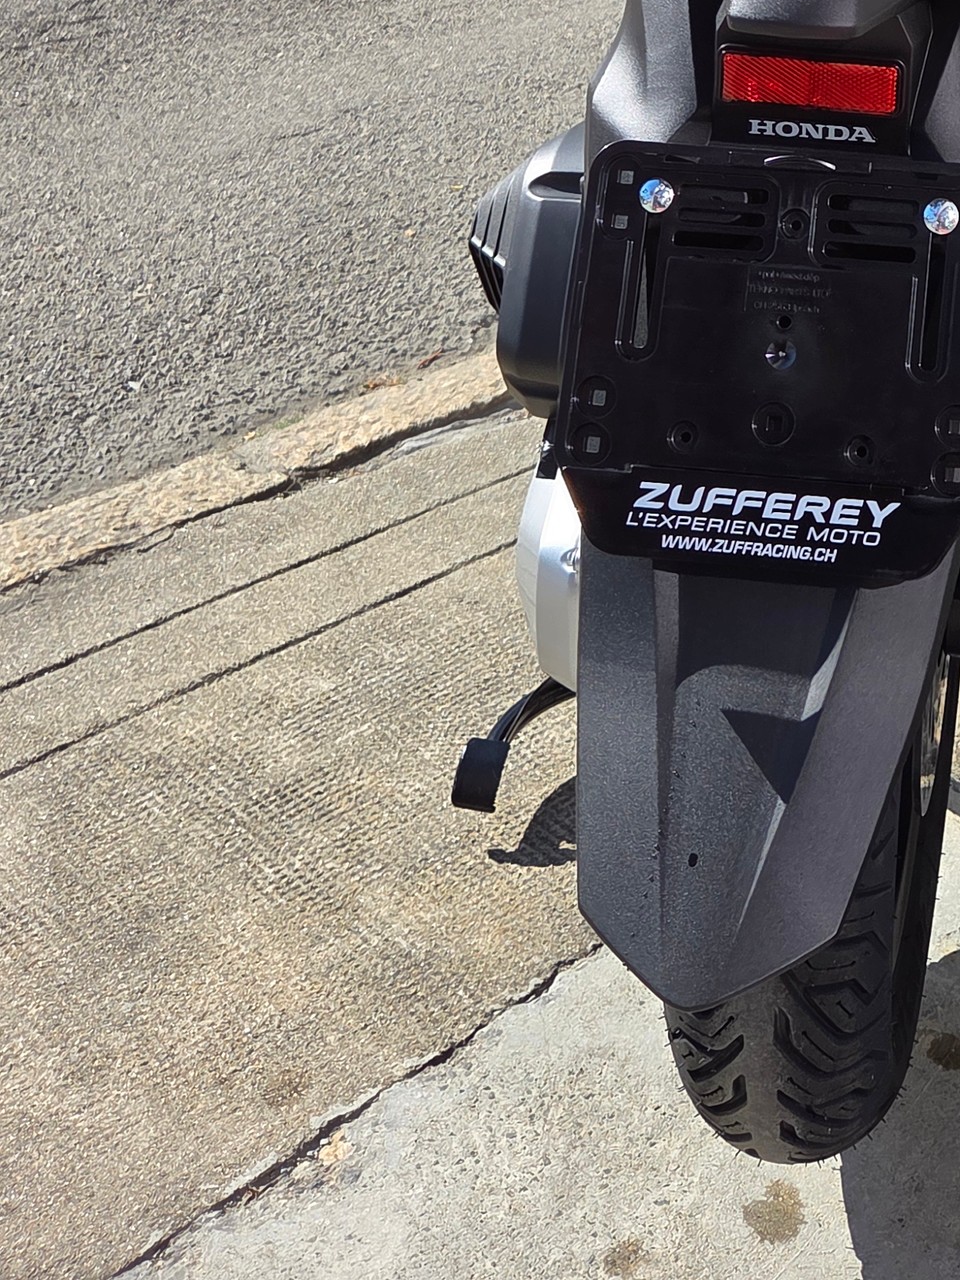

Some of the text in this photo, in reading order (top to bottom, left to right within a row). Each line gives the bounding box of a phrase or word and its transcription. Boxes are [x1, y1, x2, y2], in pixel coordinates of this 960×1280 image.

[748, 119, 877, 143] HONDA
[632, 481, 902, 529] ZUFFEREY
[625, 511, 882, 547] L'EXPERIENCE MOTO
[660, 534, 838, 563] WWW.ZUFFRACING.CH
